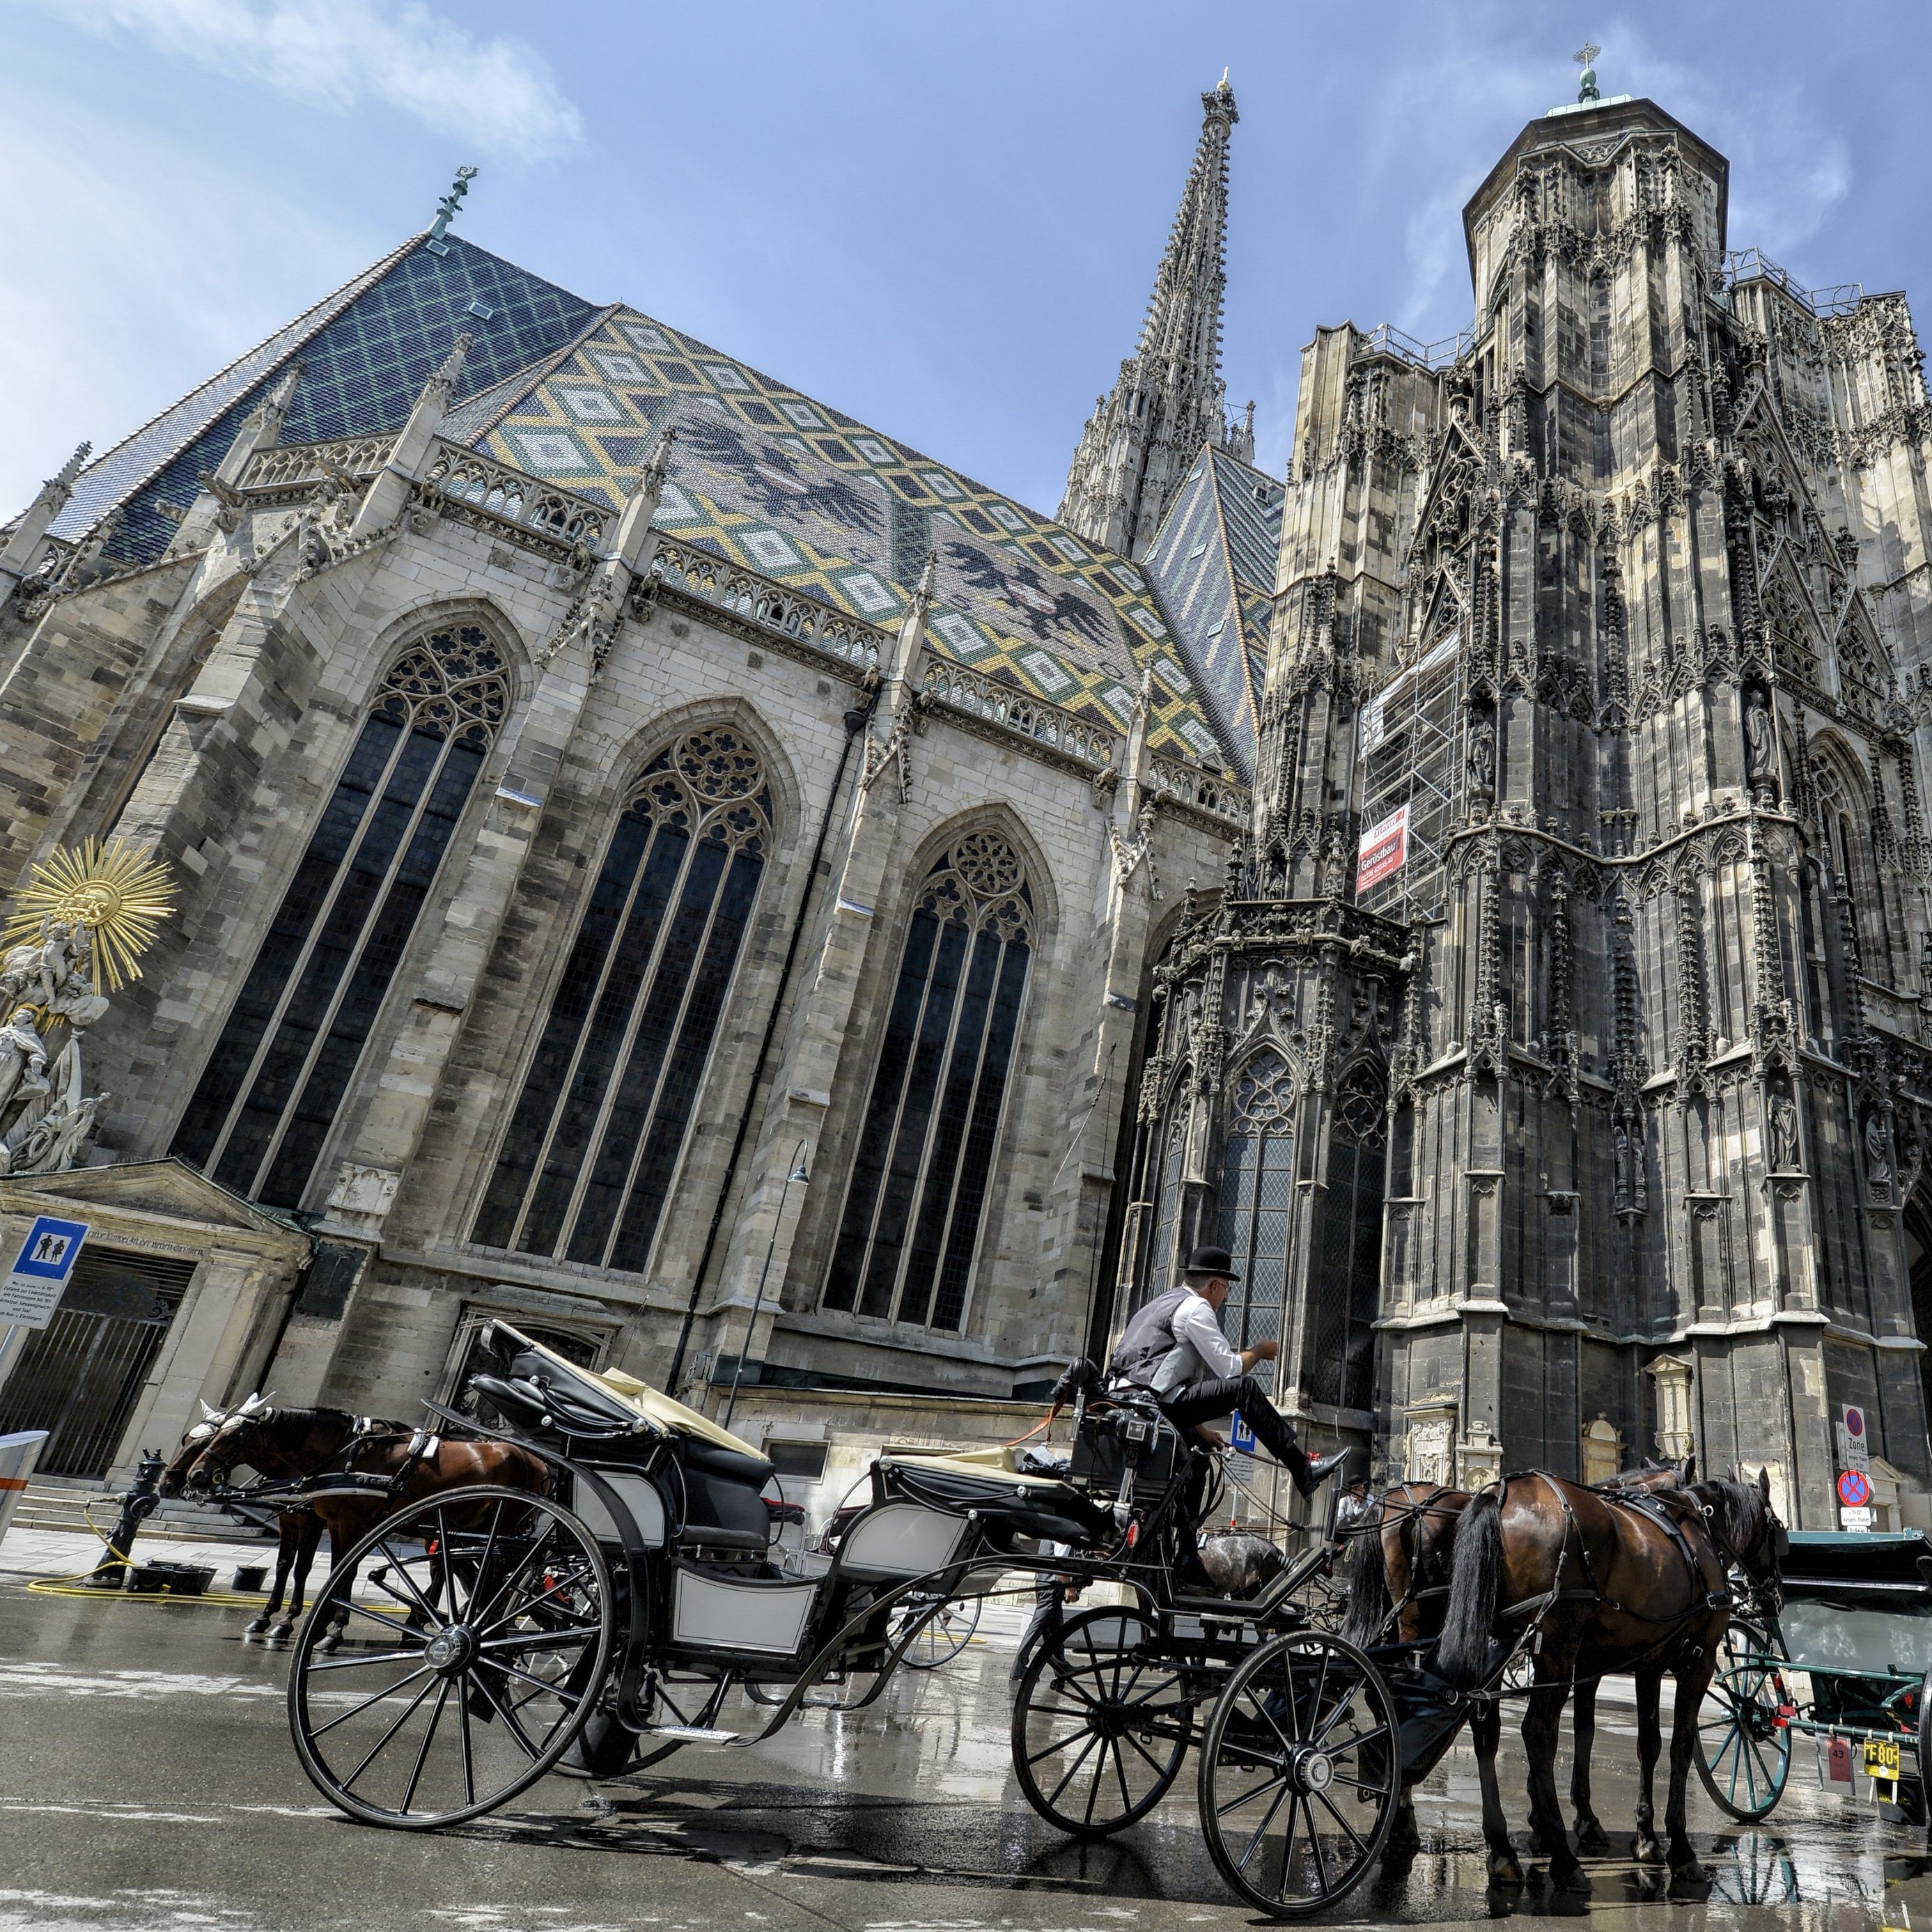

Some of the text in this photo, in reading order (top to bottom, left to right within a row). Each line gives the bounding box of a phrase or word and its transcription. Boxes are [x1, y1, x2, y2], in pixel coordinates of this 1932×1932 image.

[1361, 842, 1396, 871] Gerüstbau
[1848, 1437, 1865, 1452] Zone
[1832, 1750, 1844, 1759] 43
